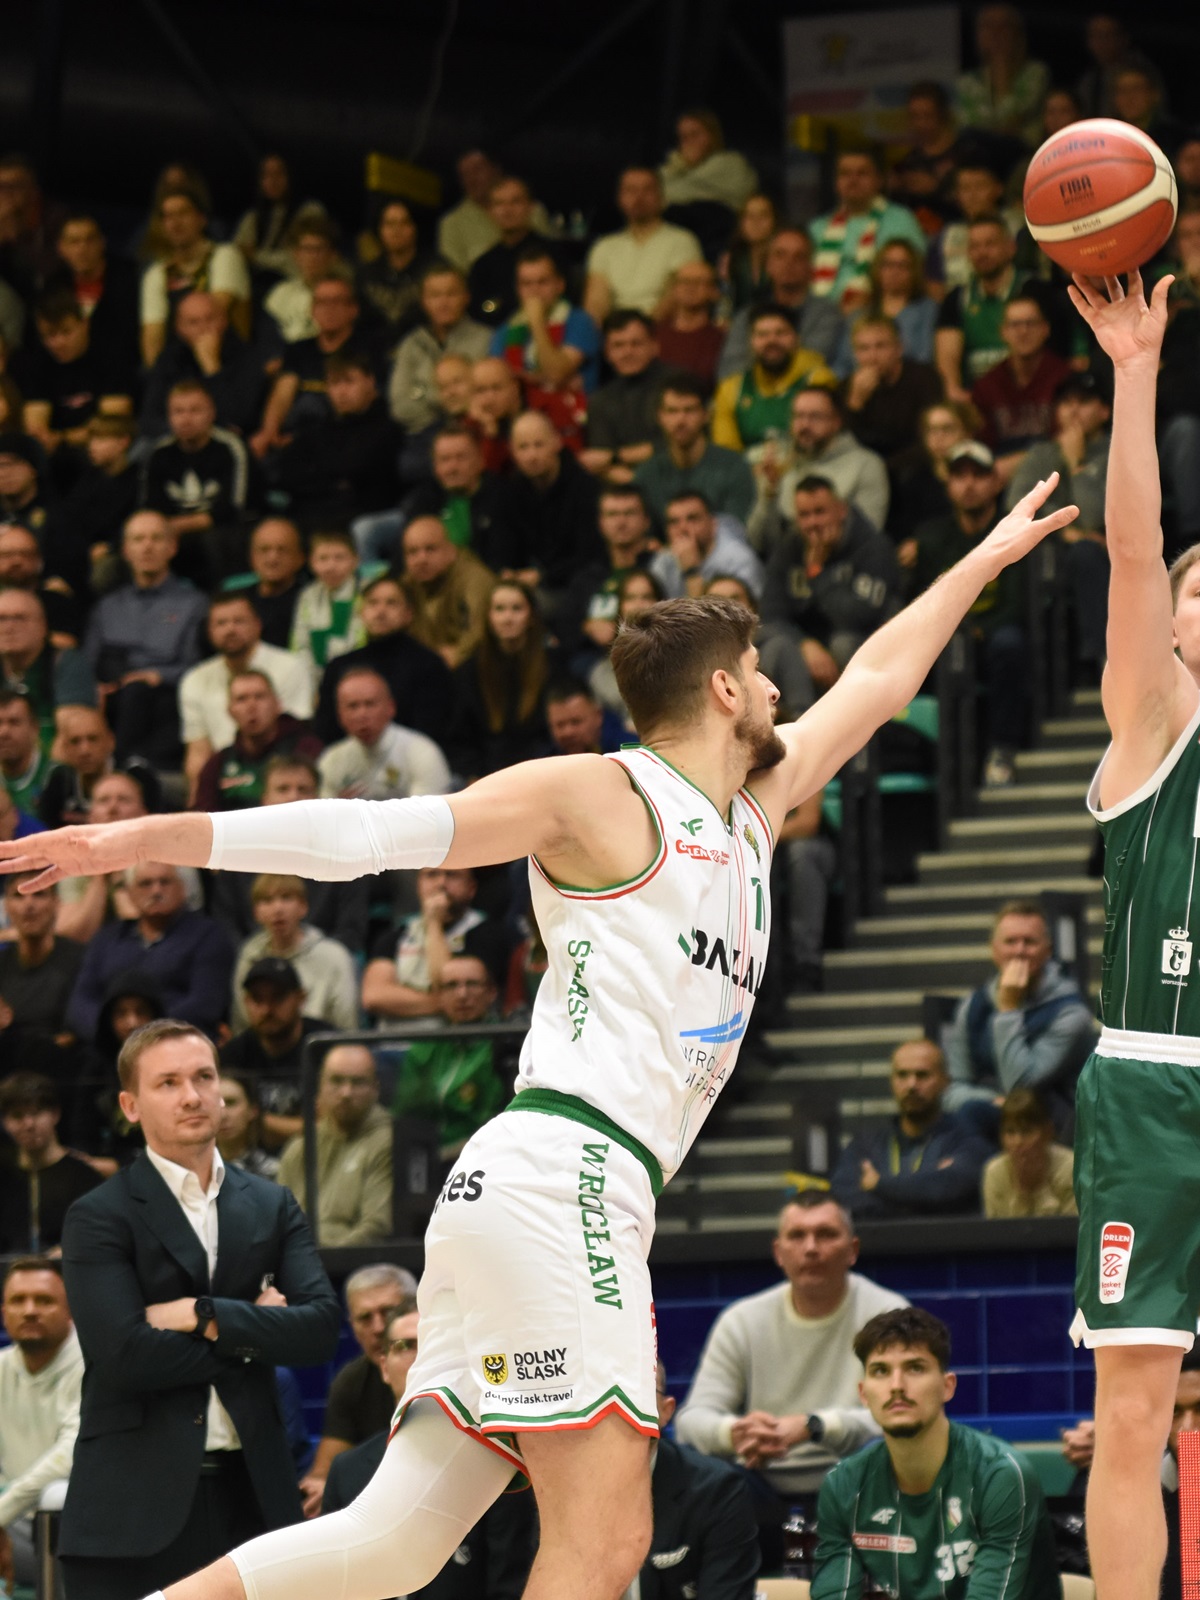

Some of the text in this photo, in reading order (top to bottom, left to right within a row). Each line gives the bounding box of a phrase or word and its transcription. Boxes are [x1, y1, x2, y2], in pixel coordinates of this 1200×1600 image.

[1059, 174, 1093, 198] FIBA
[678, 842, 708, 858] OLEN
[1103, 1233, 1130, 1243] ORLEN
[513, 1347, 567, 1366] DOLNY
[516, 1363, 567, 1381] ŚLĄSK
